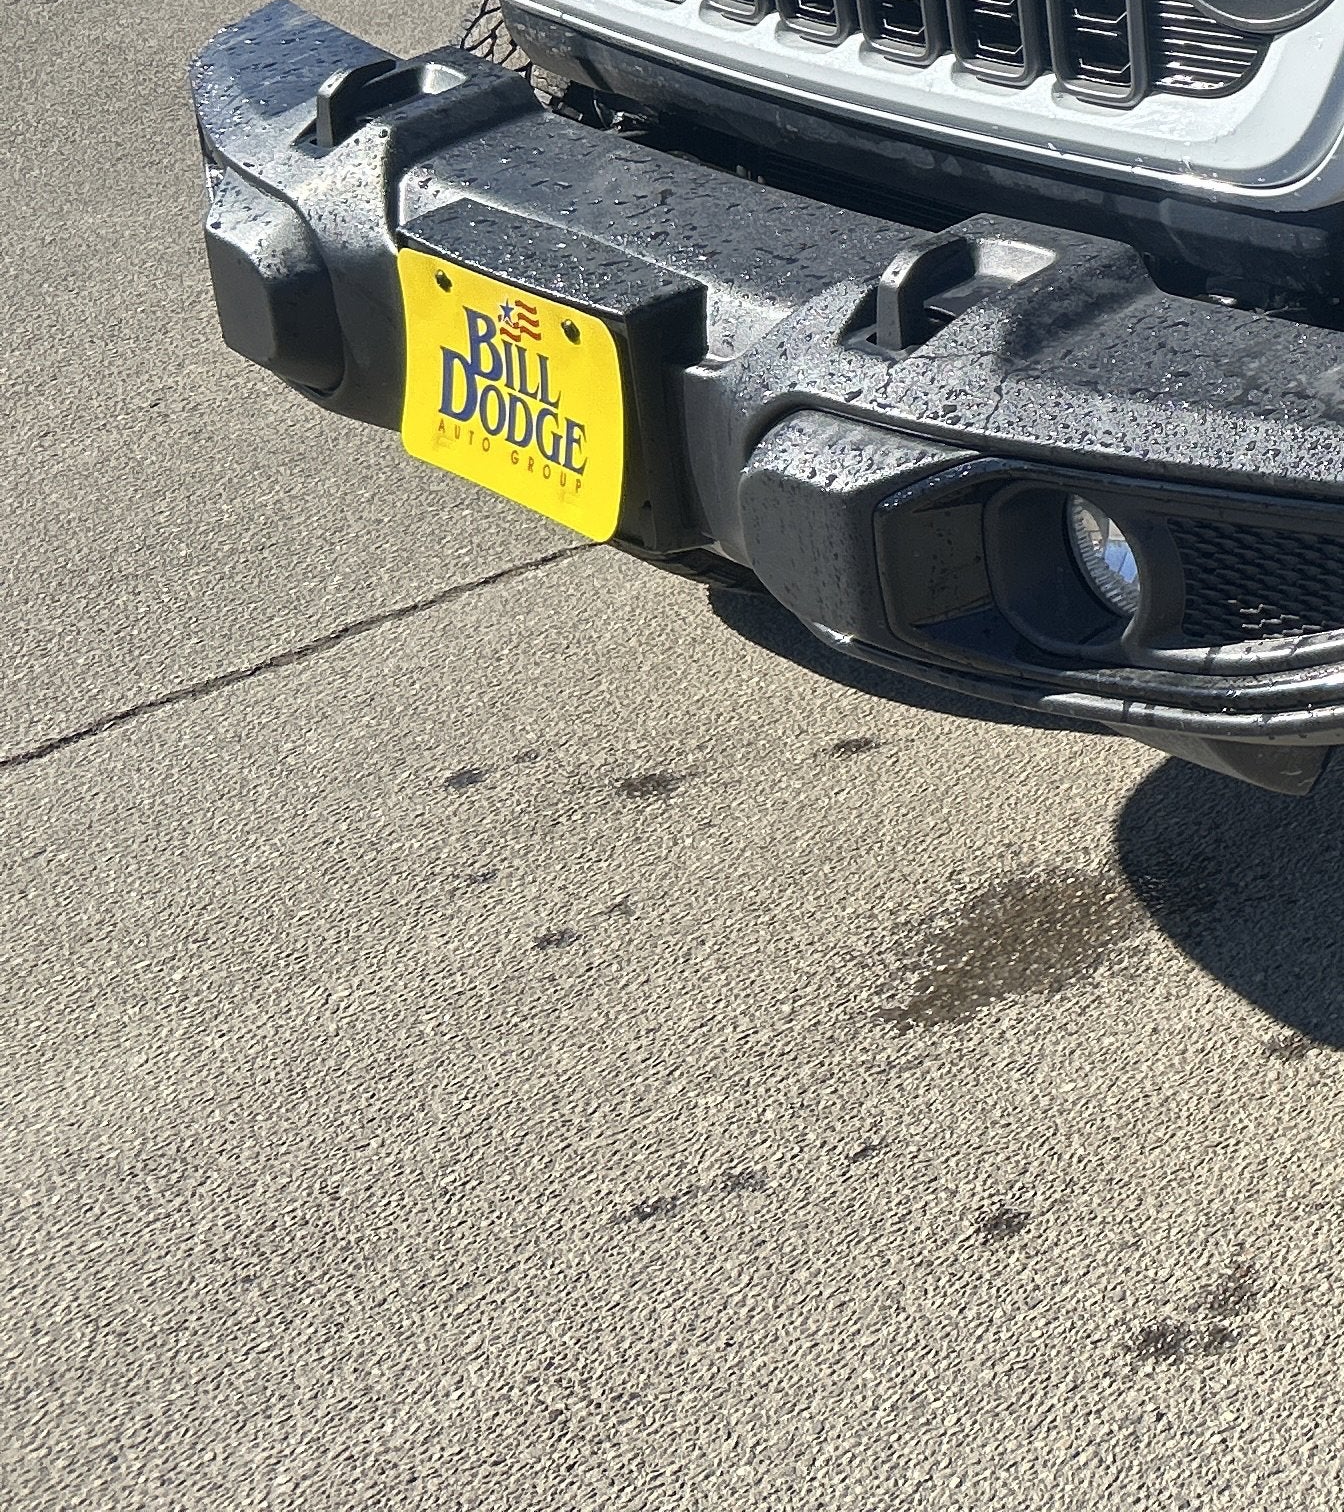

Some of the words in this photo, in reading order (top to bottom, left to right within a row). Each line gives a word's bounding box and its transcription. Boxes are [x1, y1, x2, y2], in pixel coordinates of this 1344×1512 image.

[463, 305, 563, 409] BILL
[437, 418, 491, 452] AUTO
[510, 449, 584, 495] GROUP
[438, 345, 588, 475] DODGE
